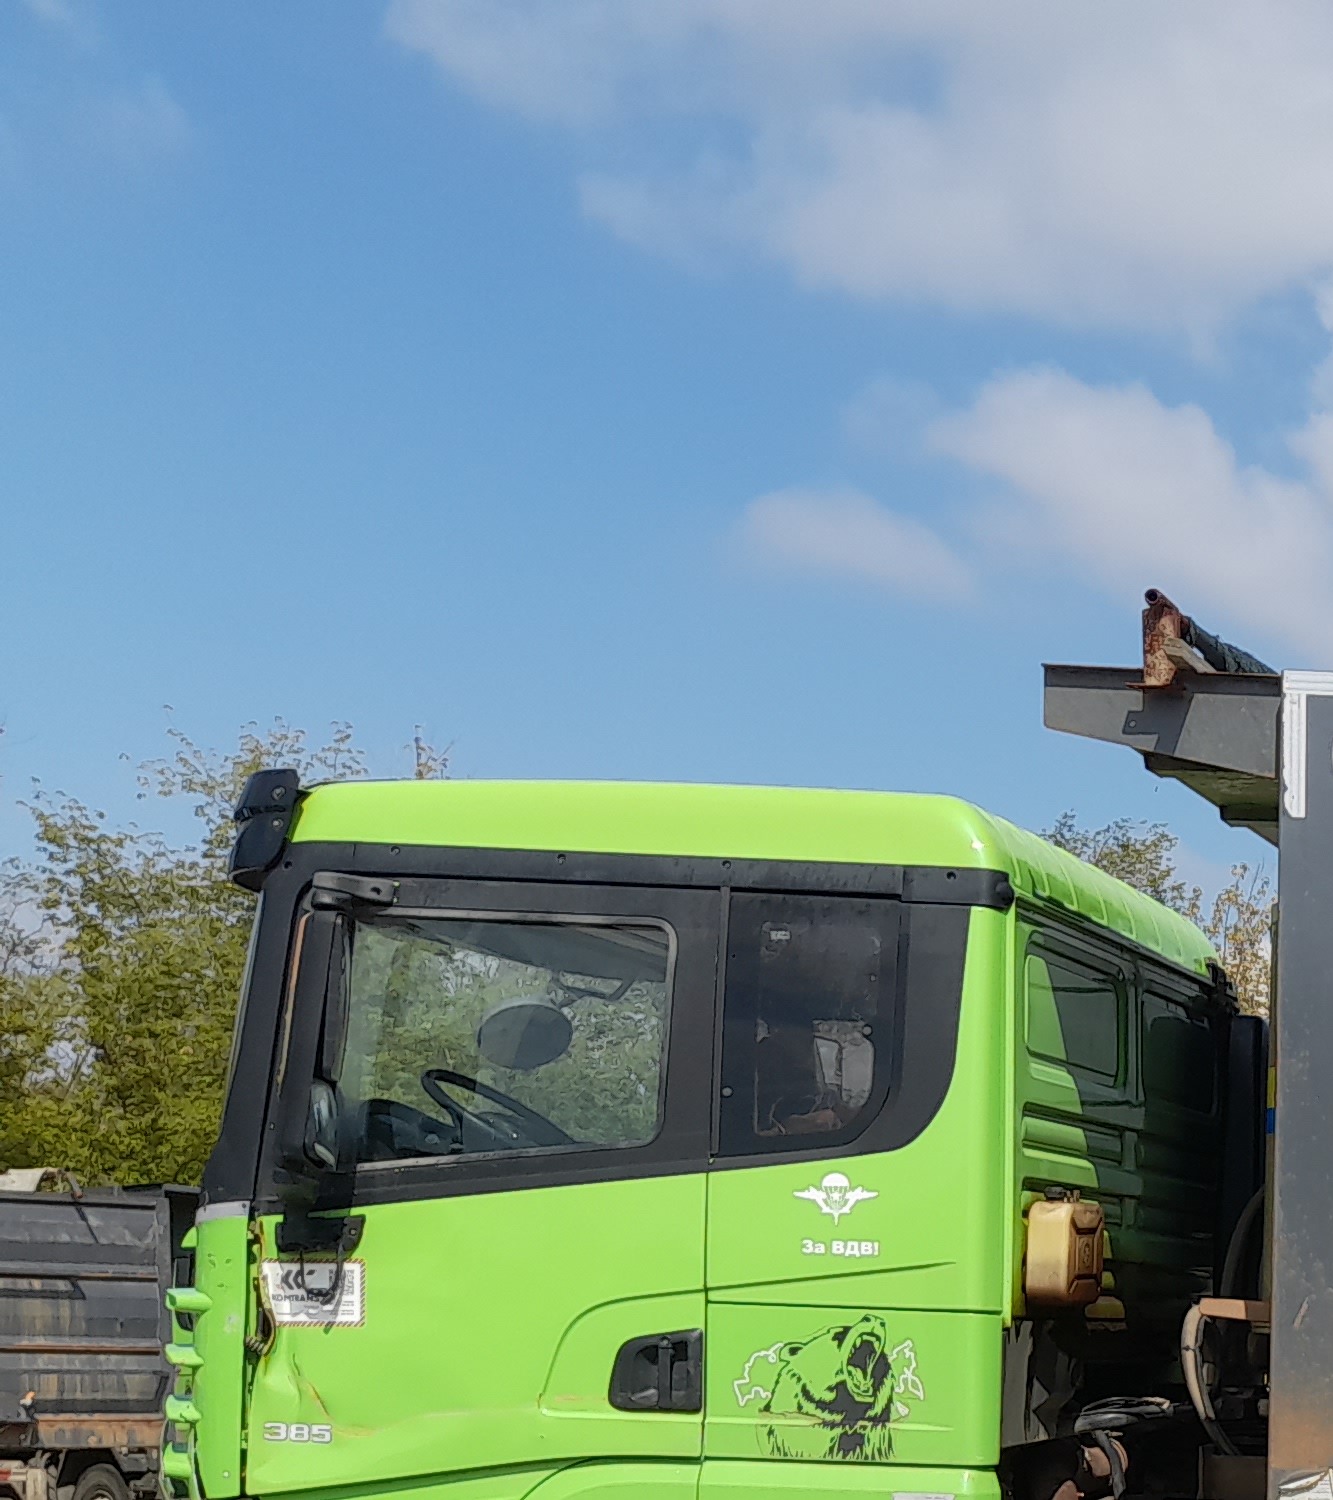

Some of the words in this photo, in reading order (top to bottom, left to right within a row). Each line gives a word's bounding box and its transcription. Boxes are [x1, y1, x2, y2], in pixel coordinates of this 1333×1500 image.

[801, 1238, 826, 1254] За
[831, 1240, 879, 1257] ВДВ!
[263, 1421, 333, 1444] 385
